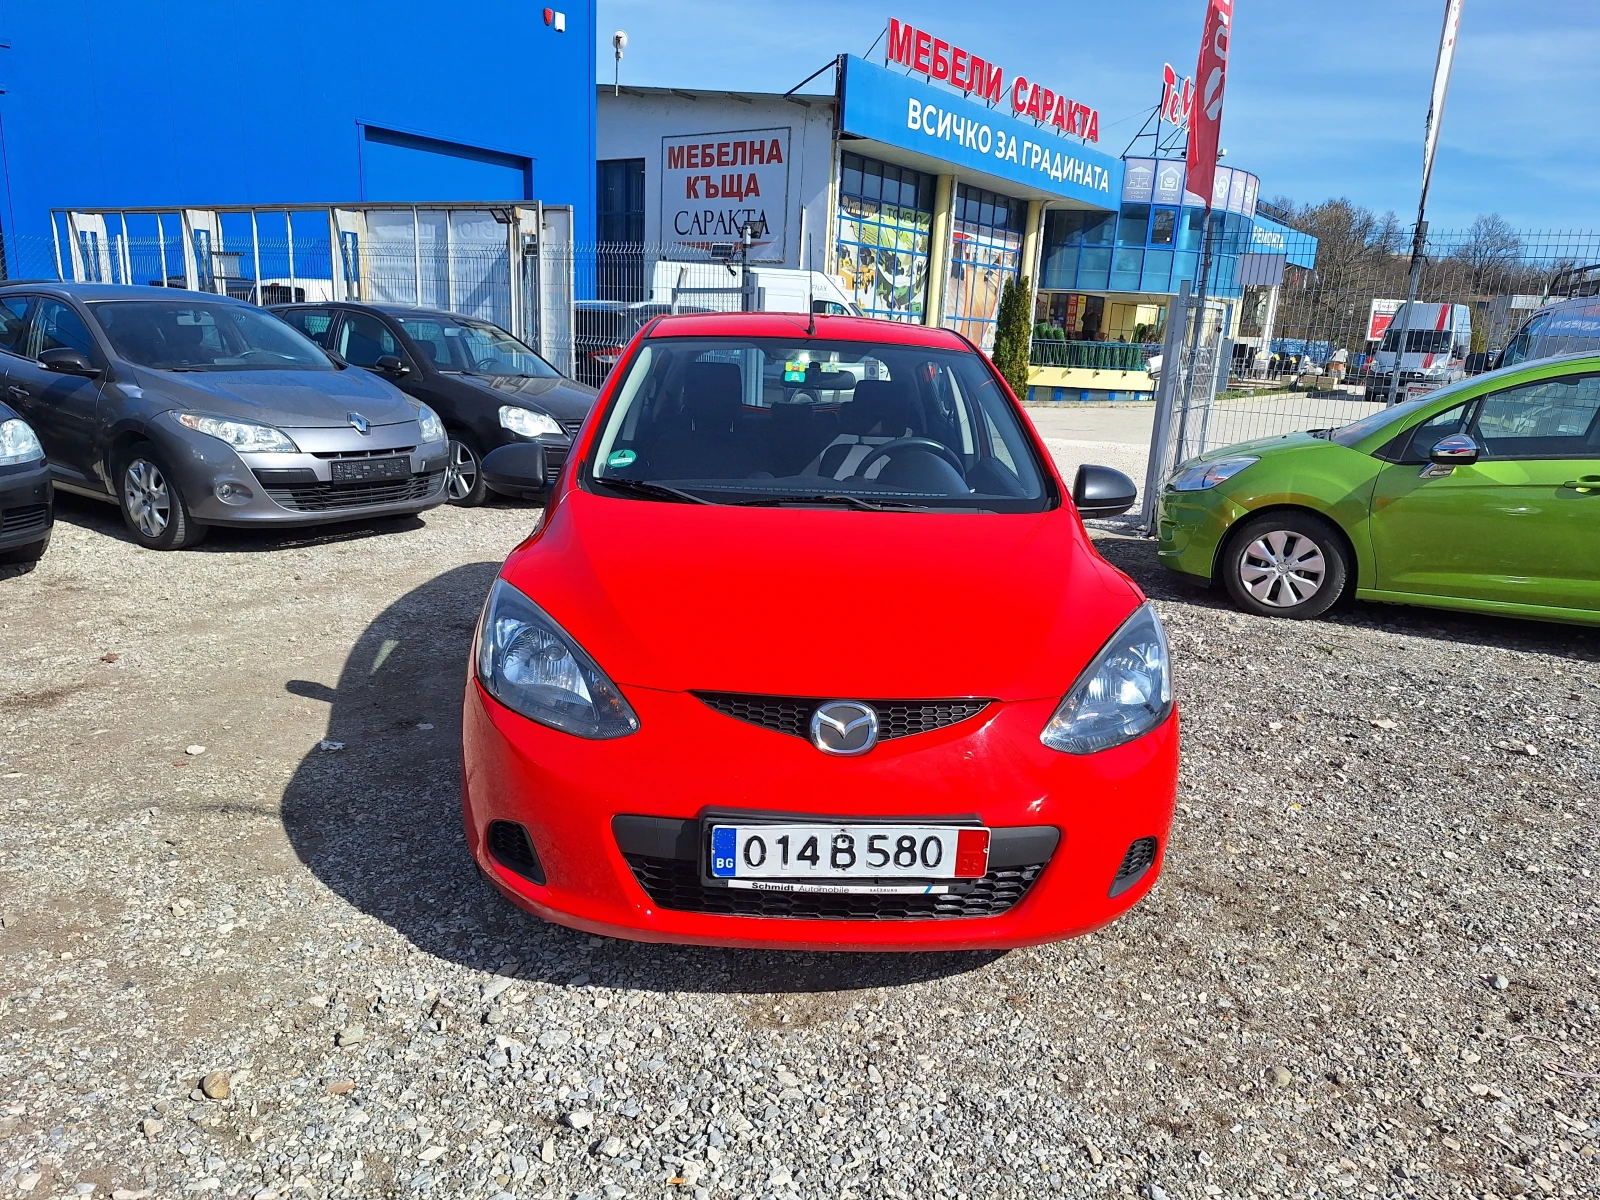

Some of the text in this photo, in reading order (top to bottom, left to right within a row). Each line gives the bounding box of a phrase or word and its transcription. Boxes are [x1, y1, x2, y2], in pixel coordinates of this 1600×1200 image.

[887, 17, 1099, 143] МЕБЕЛИ САРАКТА
[667, 139, 783, 169] МЕБЕЛНА
[907, 98, 1109, 193] ВСИЧКО ЗА ГРАДИНАТА
[686, 173, 760, 202] КЪЩА
[618, 450, 626, 458] 4
[716, 858, 734, 869] BG
[752, 882, 794, 892] Schmidt
[799, 885, 849, 894] Automobile
